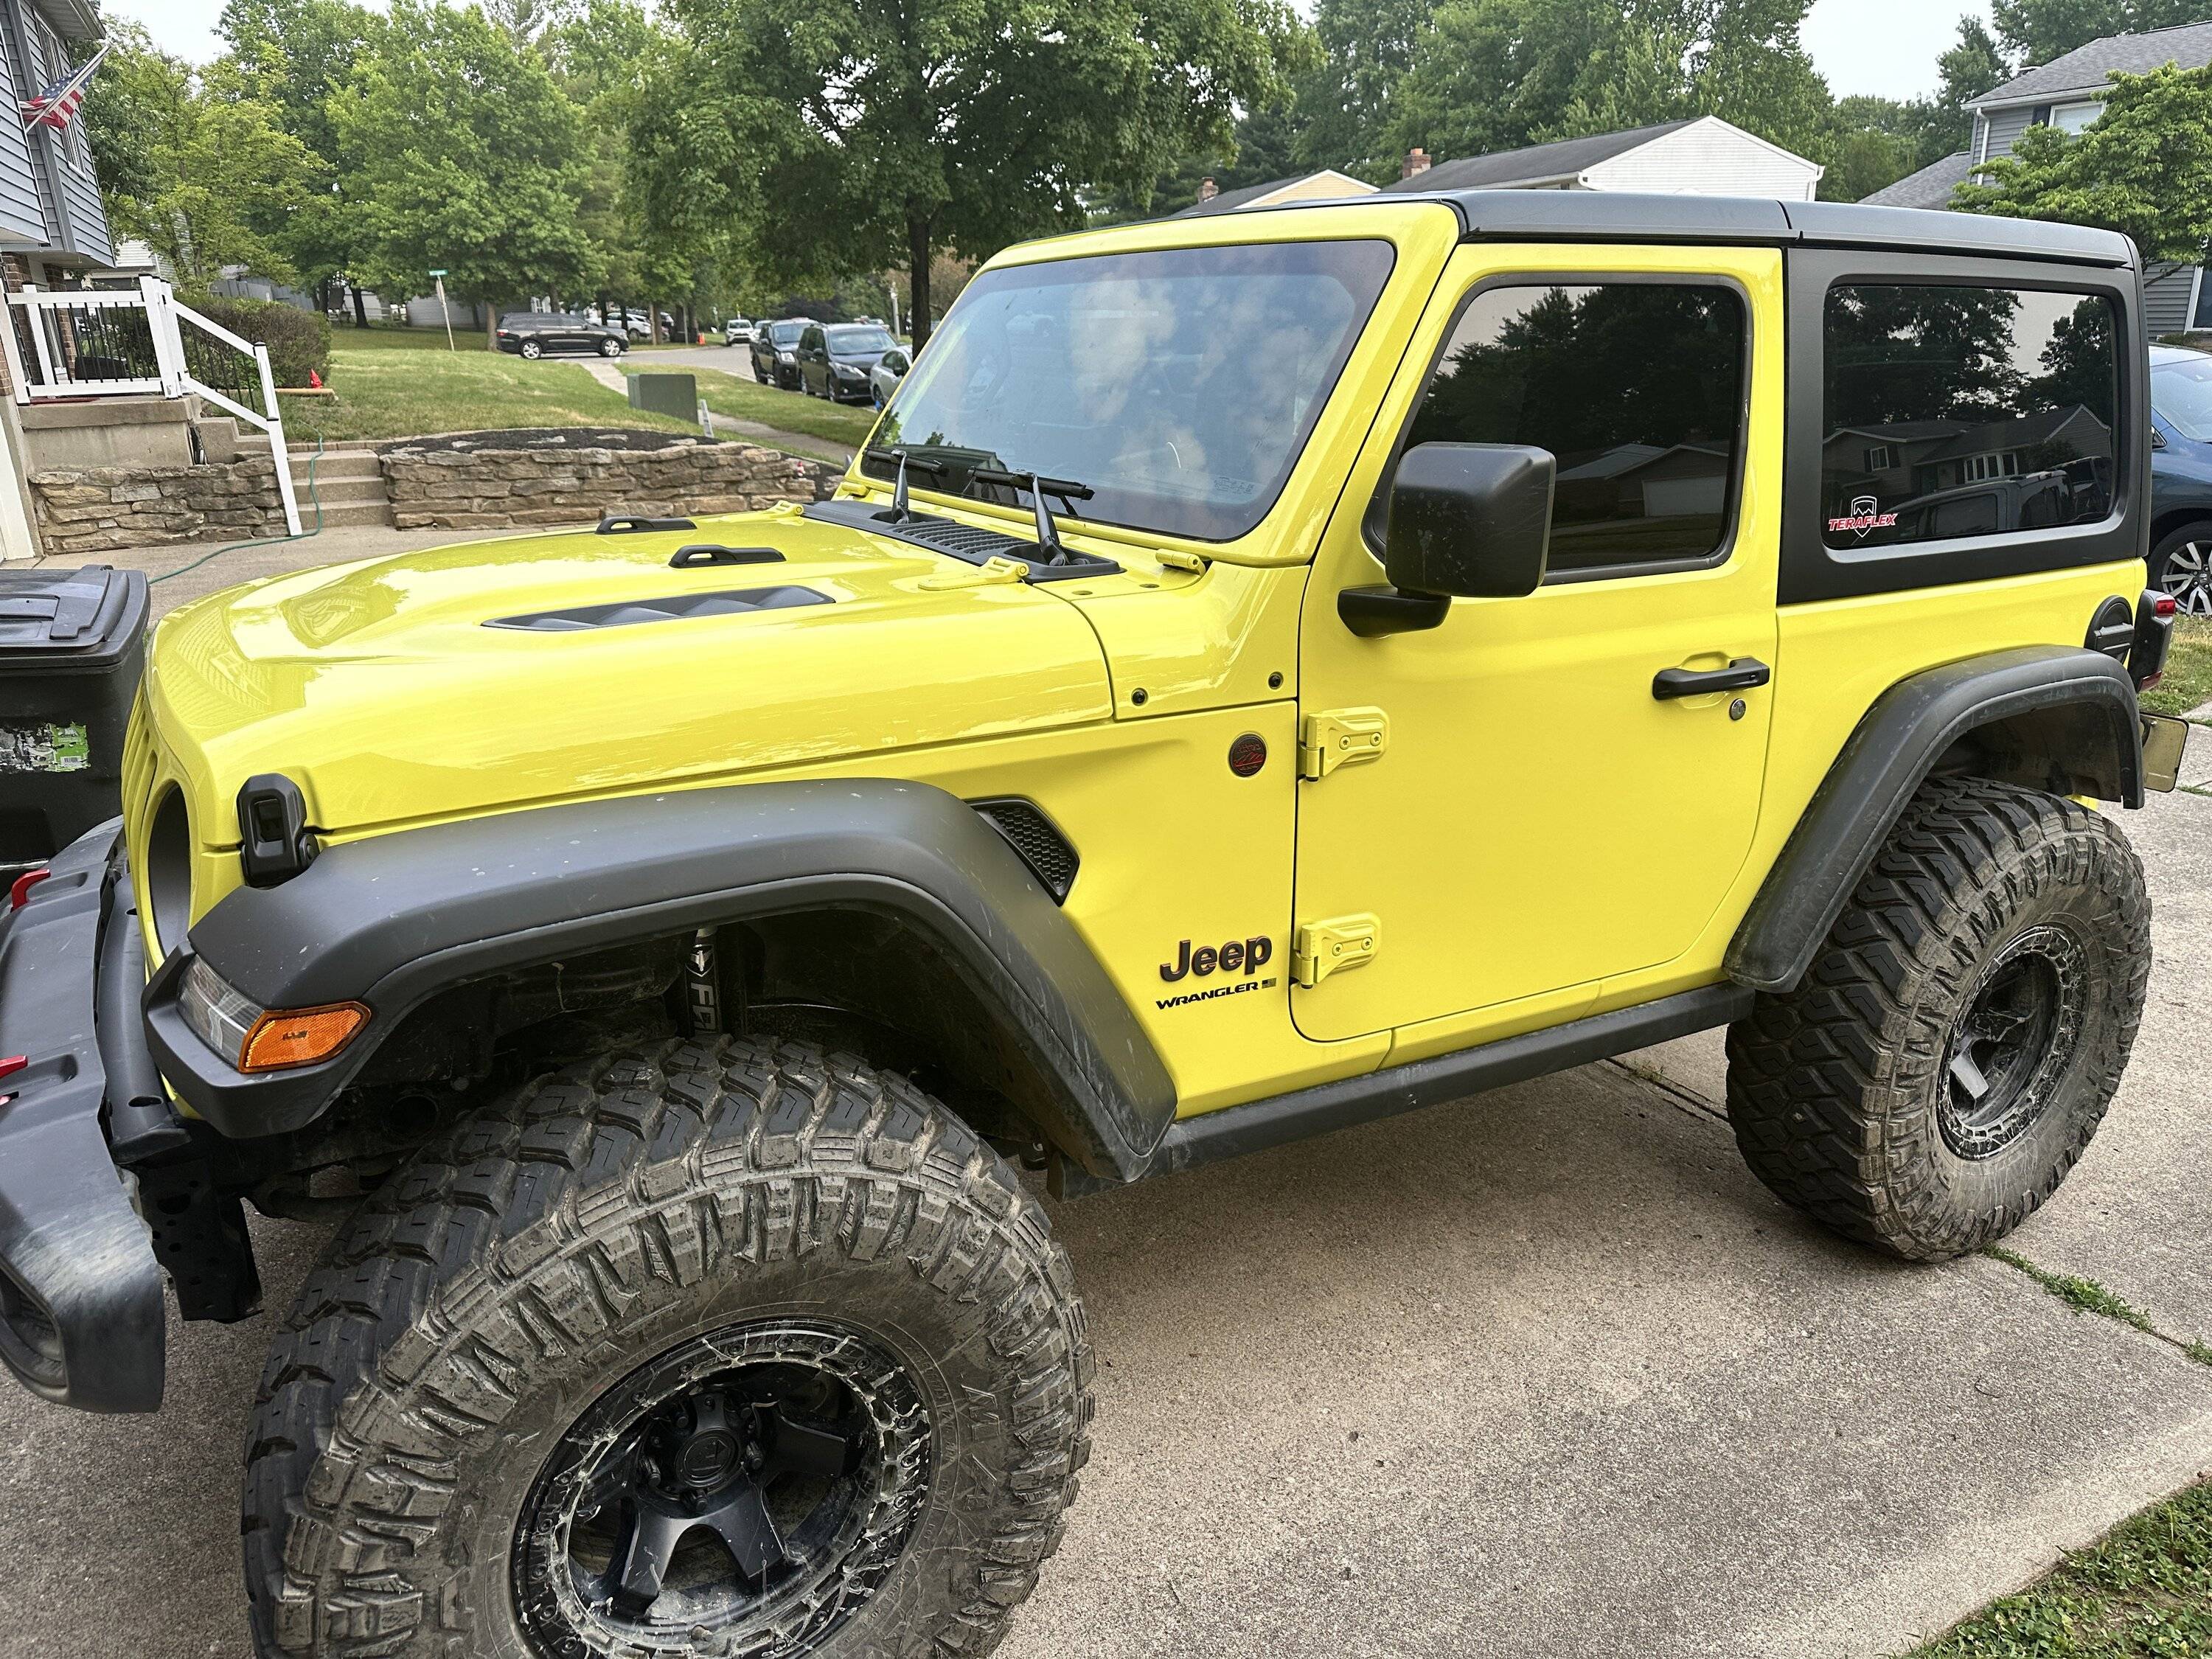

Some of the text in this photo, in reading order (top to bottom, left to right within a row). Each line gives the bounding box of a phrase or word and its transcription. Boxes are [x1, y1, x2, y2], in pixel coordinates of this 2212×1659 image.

[1829, 513, 1899, 532] TERAFLEX
[1160, 936, 1272, 981] Jeep
[1155, 982, 1258, 1009] WRANGLER
